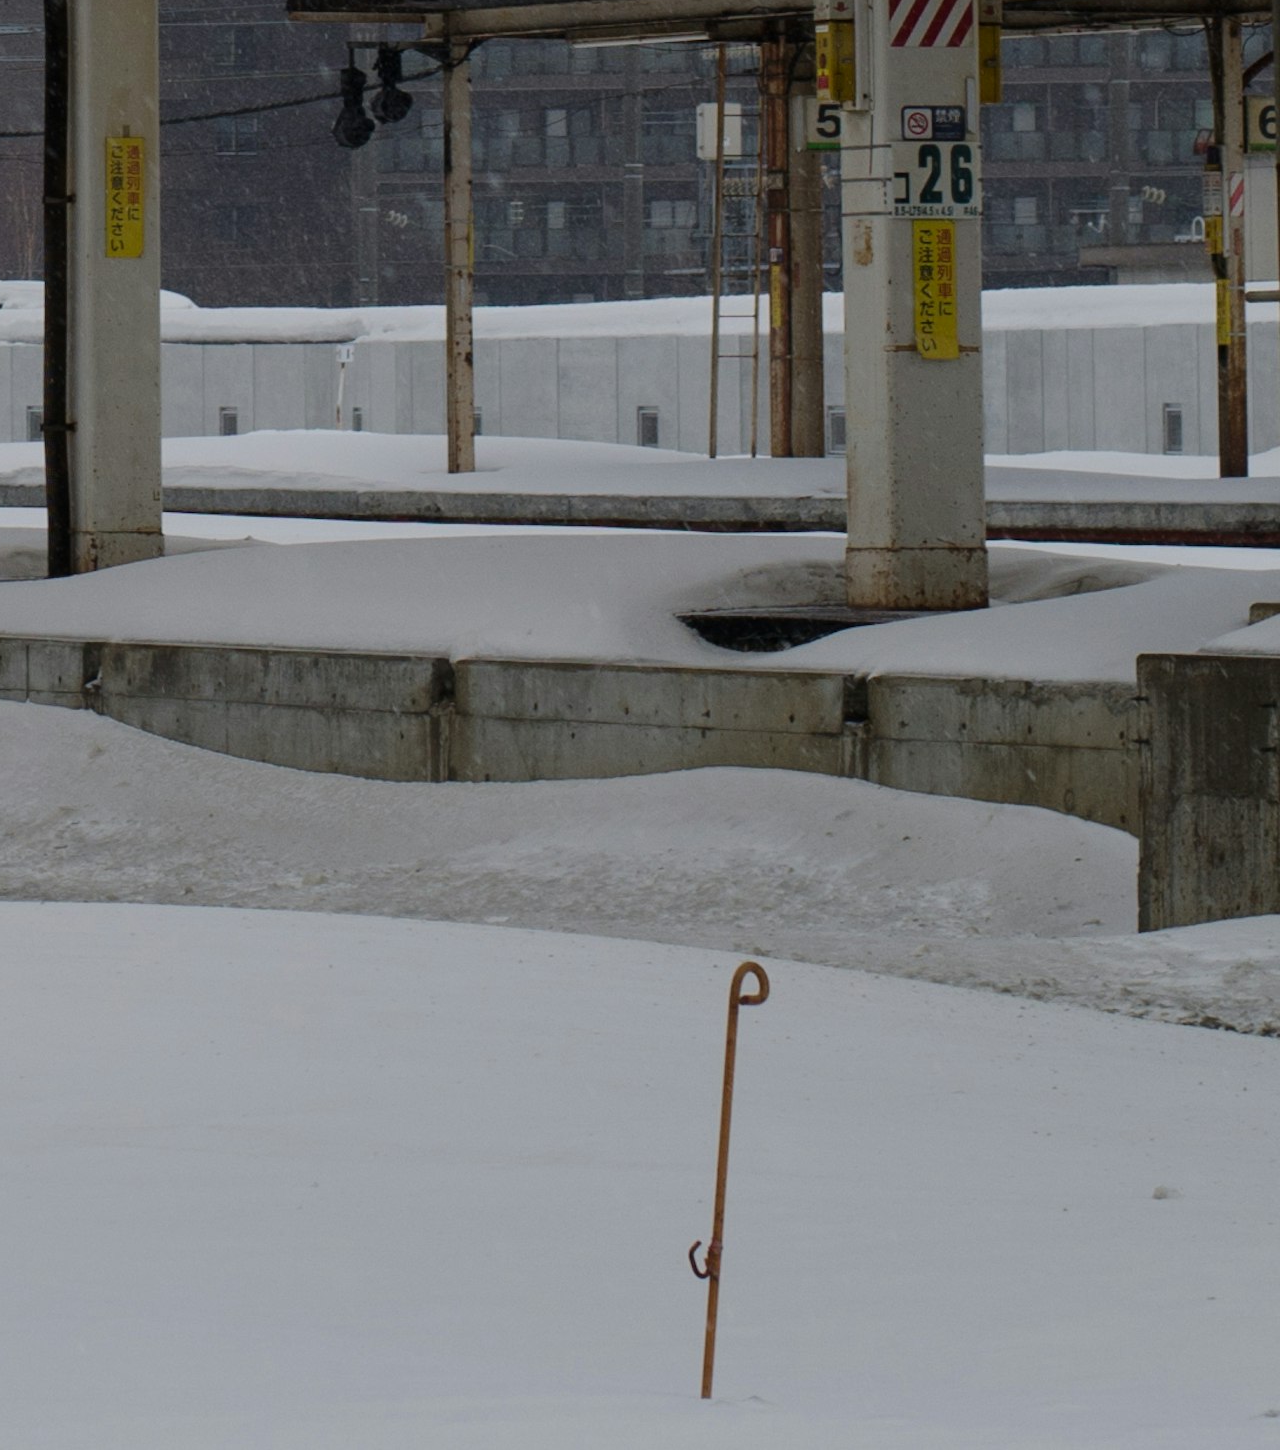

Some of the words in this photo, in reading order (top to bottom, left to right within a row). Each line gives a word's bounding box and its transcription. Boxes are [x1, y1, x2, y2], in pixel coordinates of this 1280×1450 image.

[816, 104, 841, 138] 5
[1259, 105, 1276, 140] 6
[918, 144, 973, 204] 26
[918, 229, 938, 352] ご注意ください
[936, 228, 953, 317] 通過列車に
